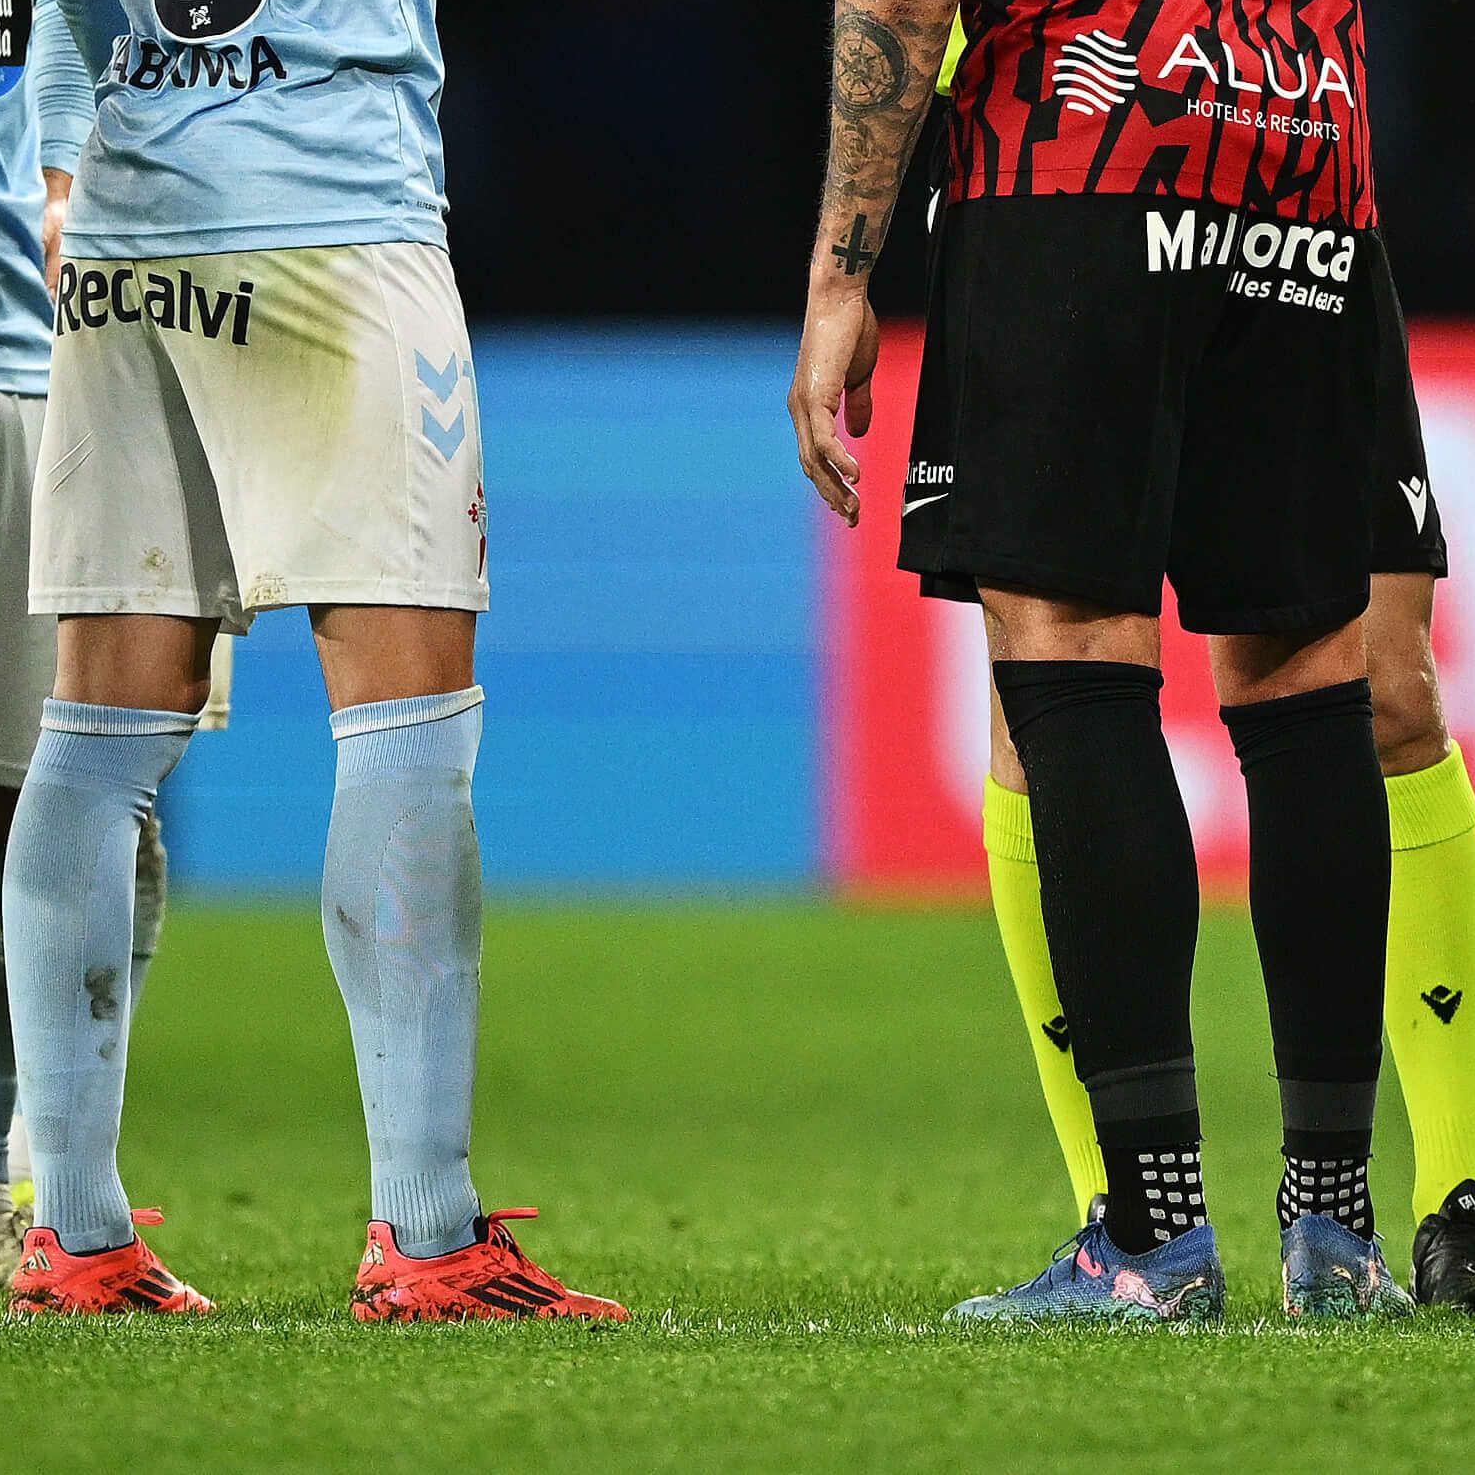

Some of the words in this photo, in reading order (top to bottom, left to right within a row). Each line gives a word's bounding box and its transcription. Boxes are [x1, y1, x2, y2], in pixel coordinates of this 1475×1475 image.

[1157, 33, 1355, 108] ALUA
[1187, 98, 1252, 126] HOTELS
[1255, 111, 1267, 129] &
[1270, 113, 1341, 141] RESORTS
[1146, 210, 1355, 282] Malorca
[57, 262, 255, 346] Recalvi
[1226, 270, 1273, 298] lles
